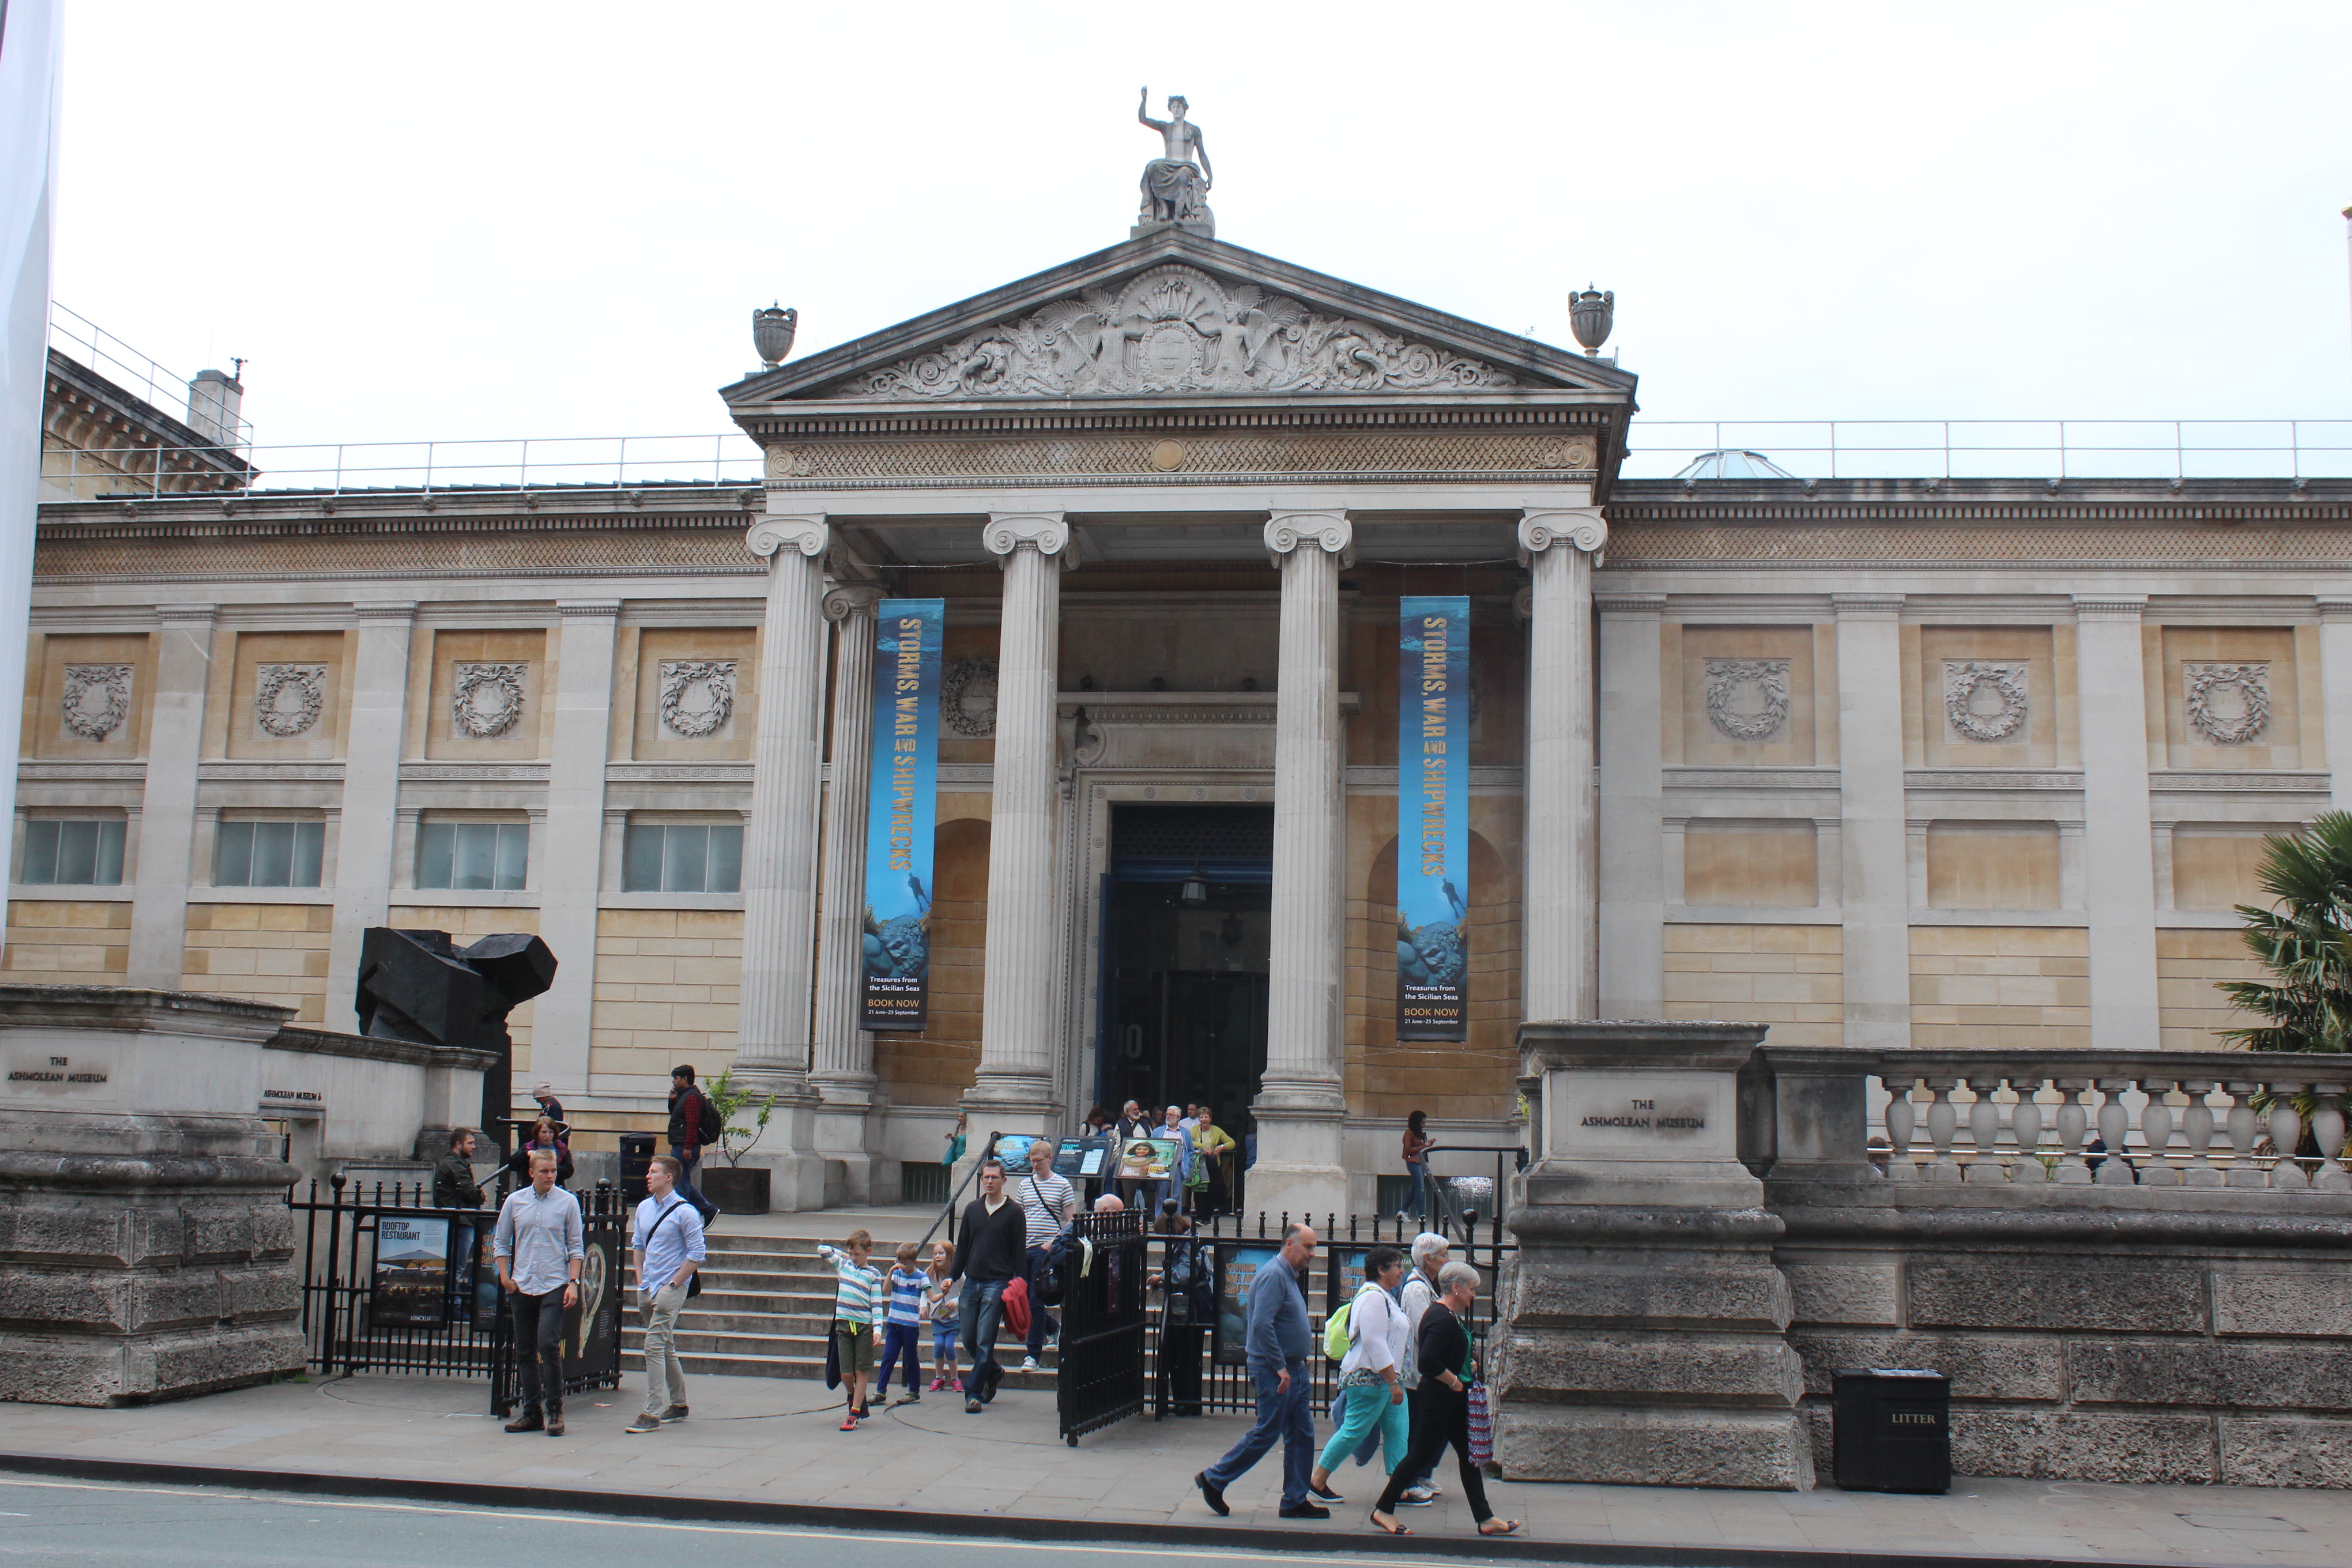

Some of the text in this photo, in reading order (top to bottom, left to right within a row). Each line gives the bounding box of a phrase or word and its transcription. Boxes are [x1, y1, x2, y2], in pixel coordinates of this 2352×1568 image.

[889, 619, 922, 871] STORMS, WAR AND SHIPWRECKS
[1421, 617, 1447, 876] STORMS, WAR AND SHIPWRECKS
[896, 999, 919, 1007] NOW
[1404, 1008, 1431, 1016] BOOK
[50, 1057, 68, 1066] THE
[7, 1071, 108, 1083] ASHMOLEAN MUSEUM
[263, 1090, 317, 1100] ASHMOLEAN MUSEUM
[1631, 1100, 1654, 1109] THE
[1581, 1117, 1705, 1128] ASHMOLEAN MUSEUM
[382, 1222, 410, 1230] ROOFTOP
[381, 1230, 421, 1240] RESTAURANT
[1226, 1263, 1256, 1273] STORMS
[1341, 1267, 1366, 1276] STORM
[1225, 1273, 1256, 1283] WAR AN
[1341, 1277, 1356, 1286] WAR
[1891, 1414, 1936, 1424] LITTER
